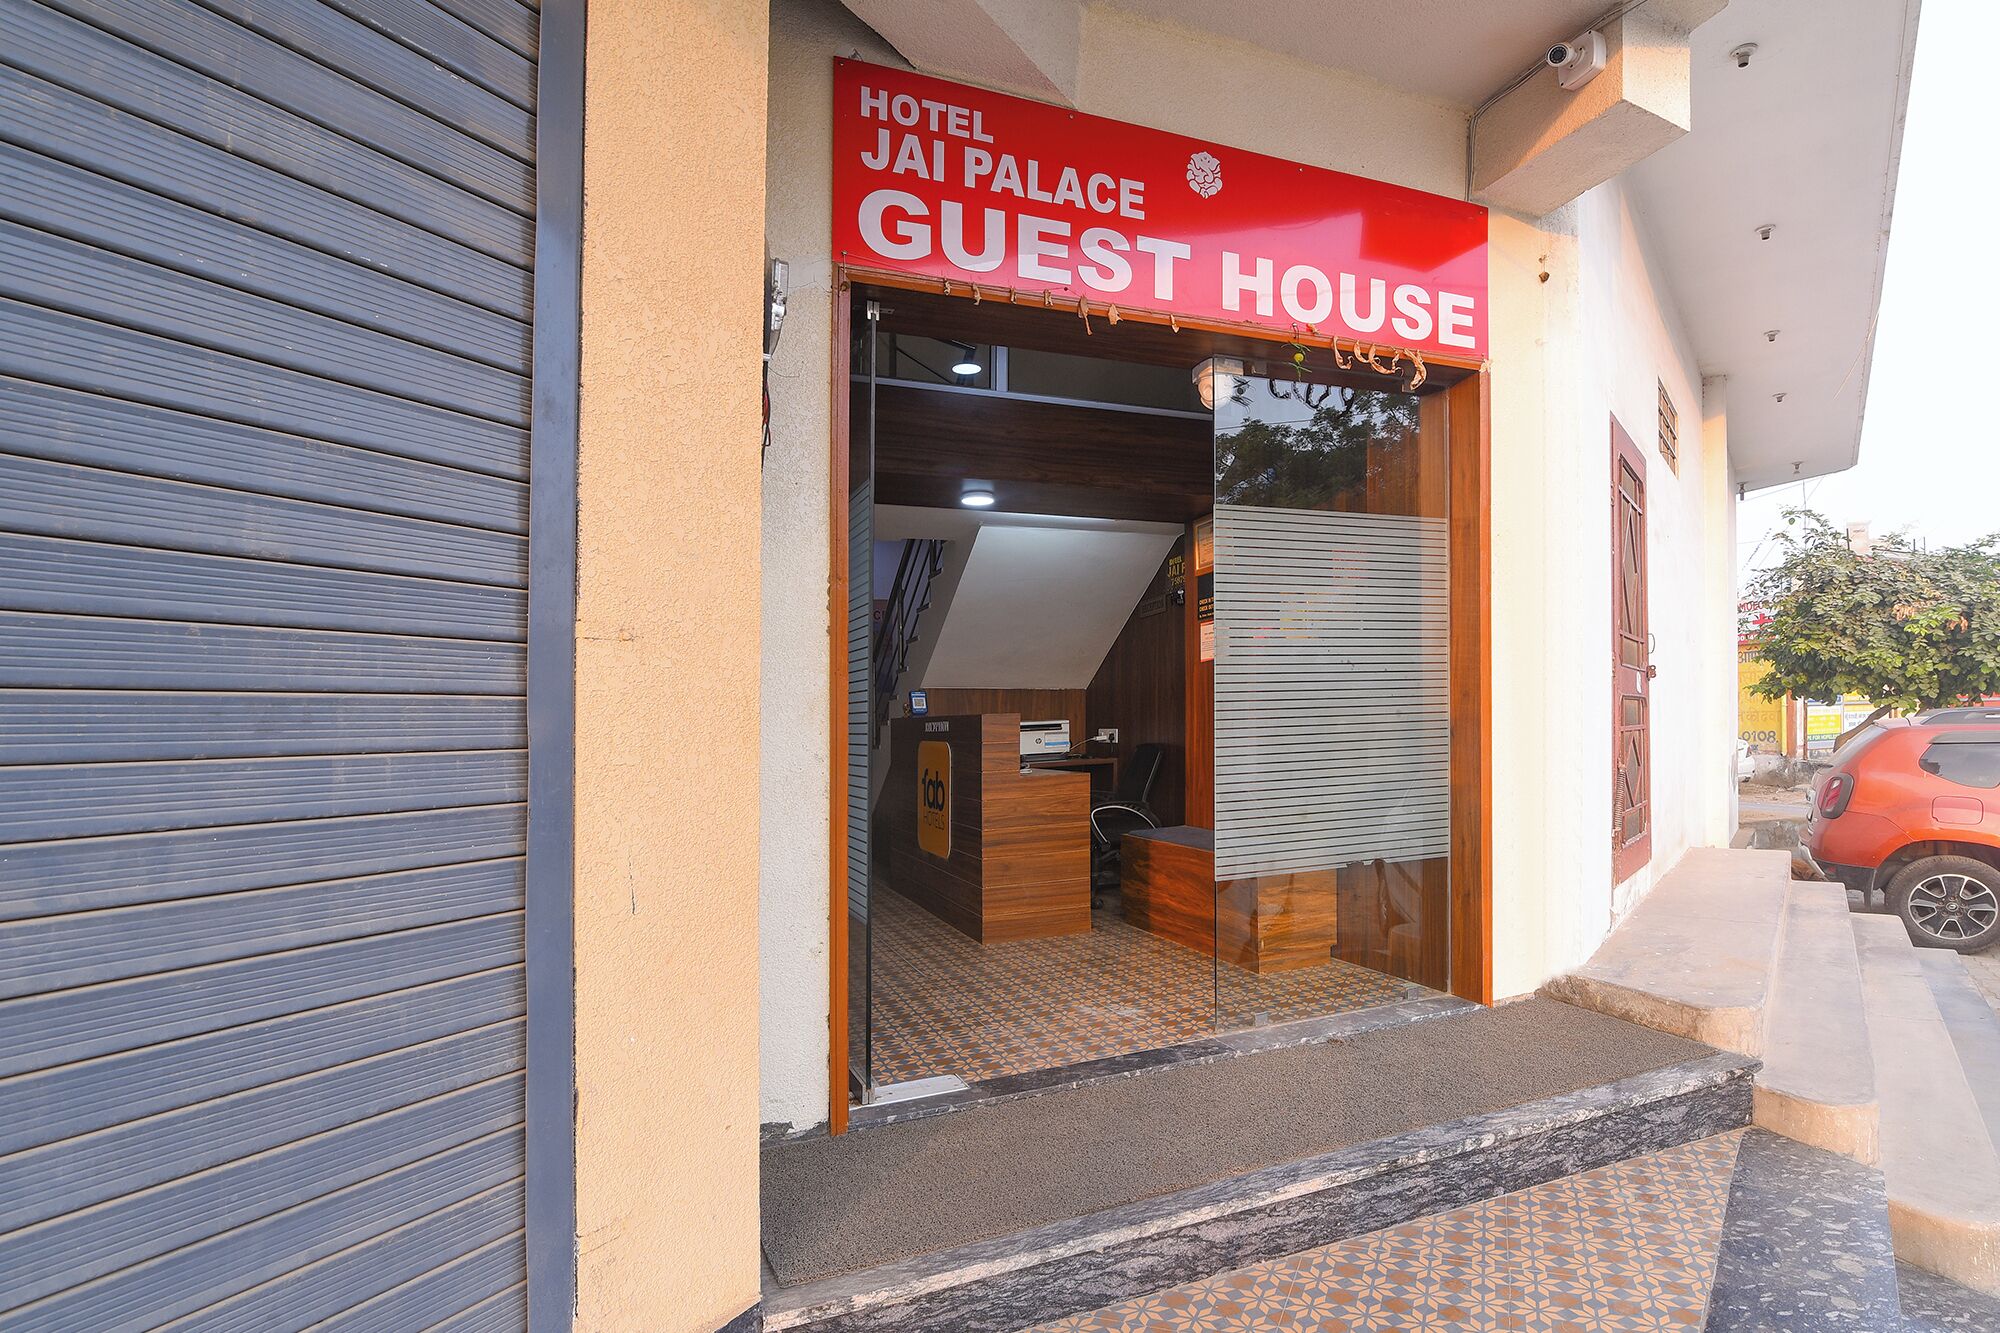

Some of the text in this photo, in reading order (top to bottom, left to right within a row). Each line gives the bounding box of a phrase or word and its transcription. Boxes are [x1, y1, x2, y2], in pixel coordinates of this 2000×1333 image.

[860, 85, 994, 144] HOTEL
[860, 128, 1146, 220] JAI PALACE
[857, 189, 1477, 349] GUEST HOUSE
[921, 768, 945, 811] fab
